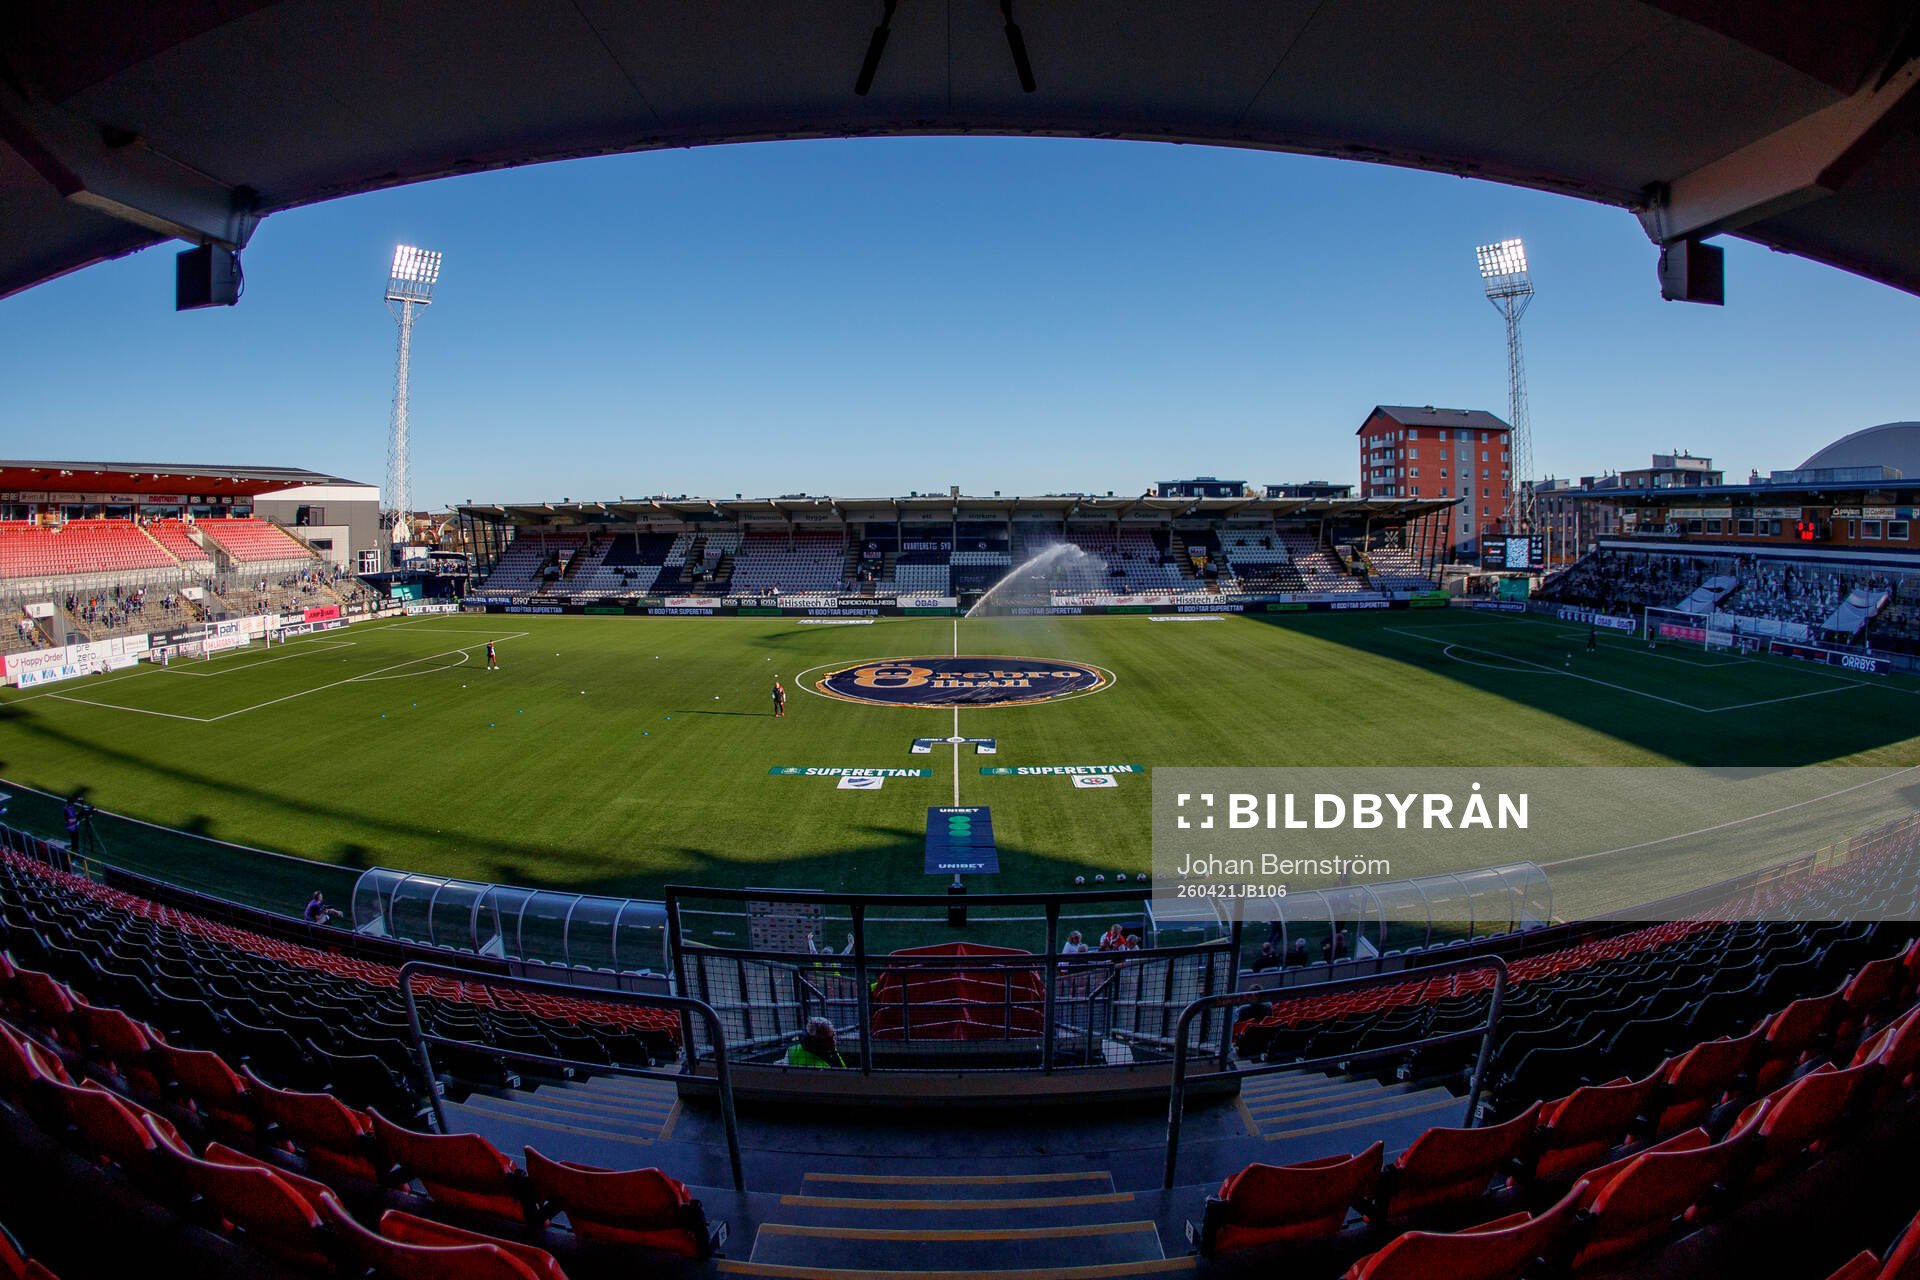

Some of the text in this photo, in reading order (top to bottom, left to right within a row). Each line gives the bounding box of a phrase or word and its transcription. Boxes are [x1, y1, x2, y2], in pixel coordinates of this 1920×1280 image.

[785, 599, 837, 607] Hisstech AB
[1175, 595, 1211, 604] Hisstech
[1212, 595, 1226, 605] AB
[842, 608, 878, 616] SUPERETTAN
[20, 653, 63, 667] Happy Order
[77, 651, 96, 662] zero
[1842, 655, 1876, 671] ORRBYS
[805, 767, 921, 777] SUPERETTAN
[1017, 764, 1133, 775] SUPERETTAN
